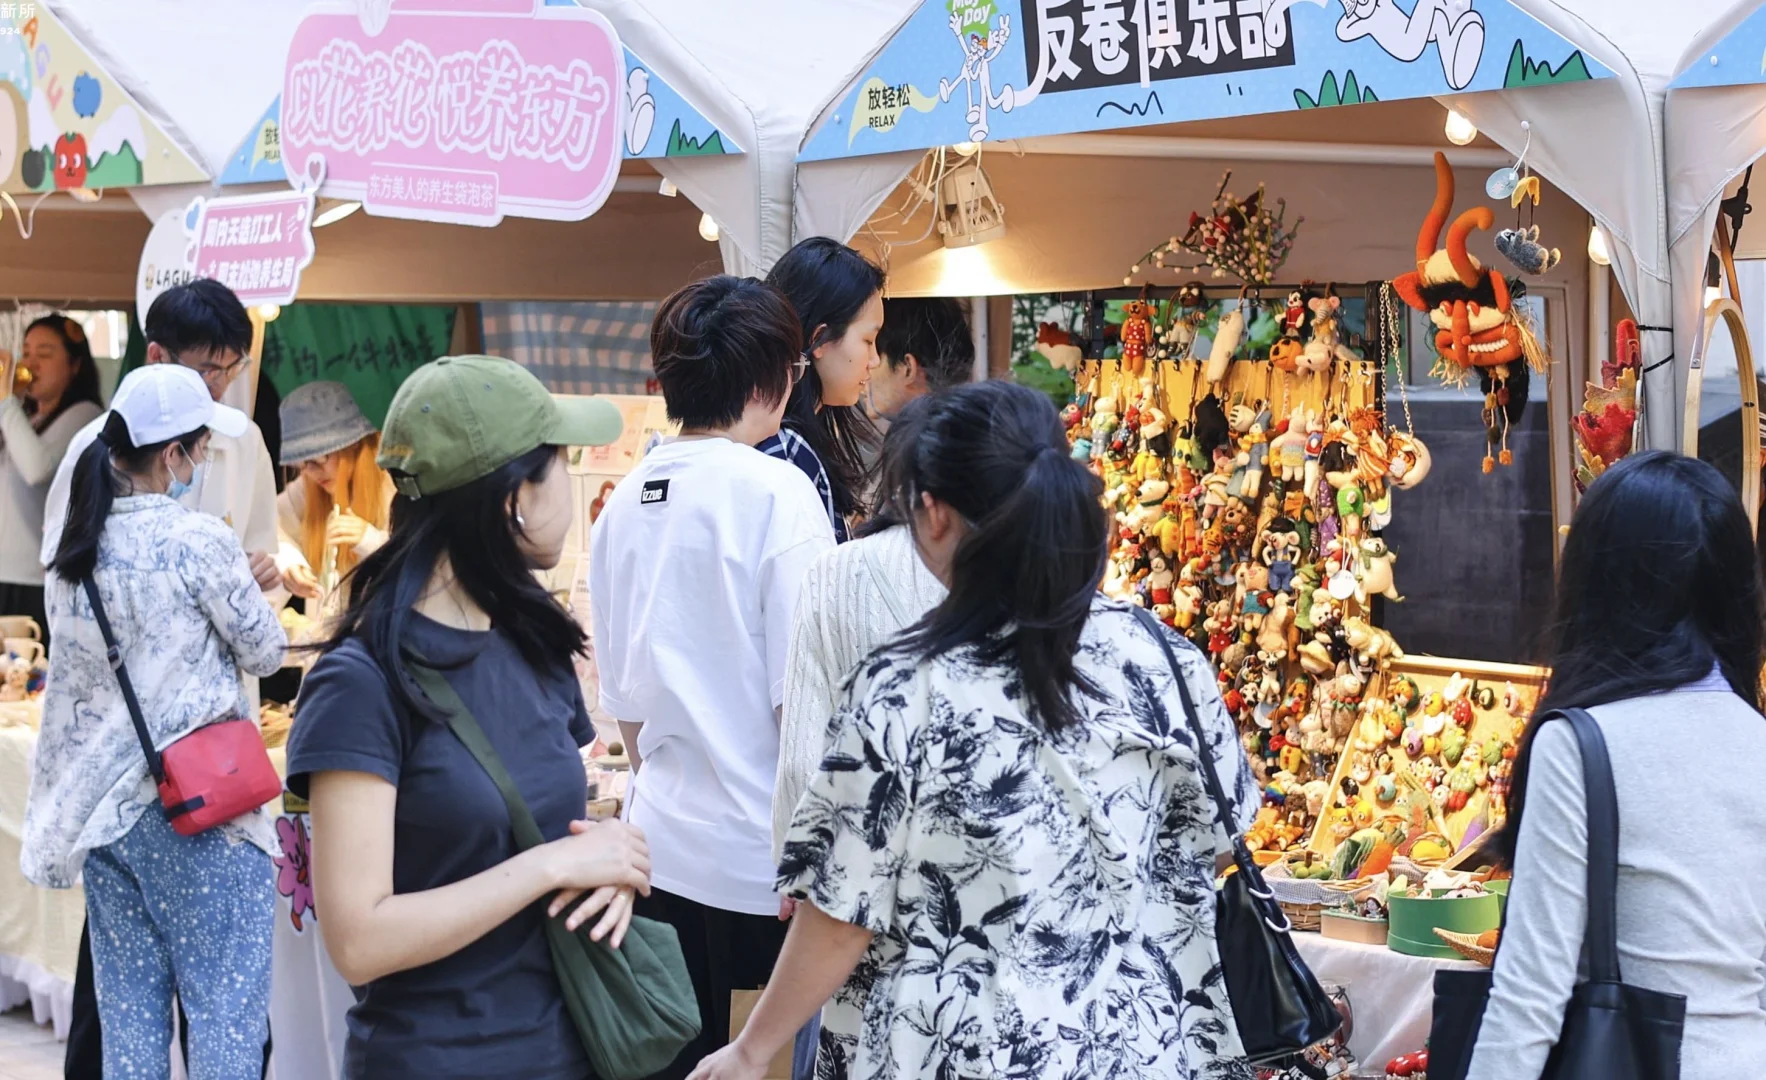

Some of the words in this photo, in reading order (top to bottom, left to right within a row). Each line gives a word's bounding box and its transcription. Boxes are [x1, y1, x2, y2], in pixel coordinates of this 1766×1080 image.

[288, 46, 606, 158] 以花养花悦养东方
[868, 83, 911, 111] 放轻松
[868, 114, 896, 129] RELAX
[369, 173, 495, 208] 东方美人的养生袋泡茶
[642, 487, 664, 502] izzue
